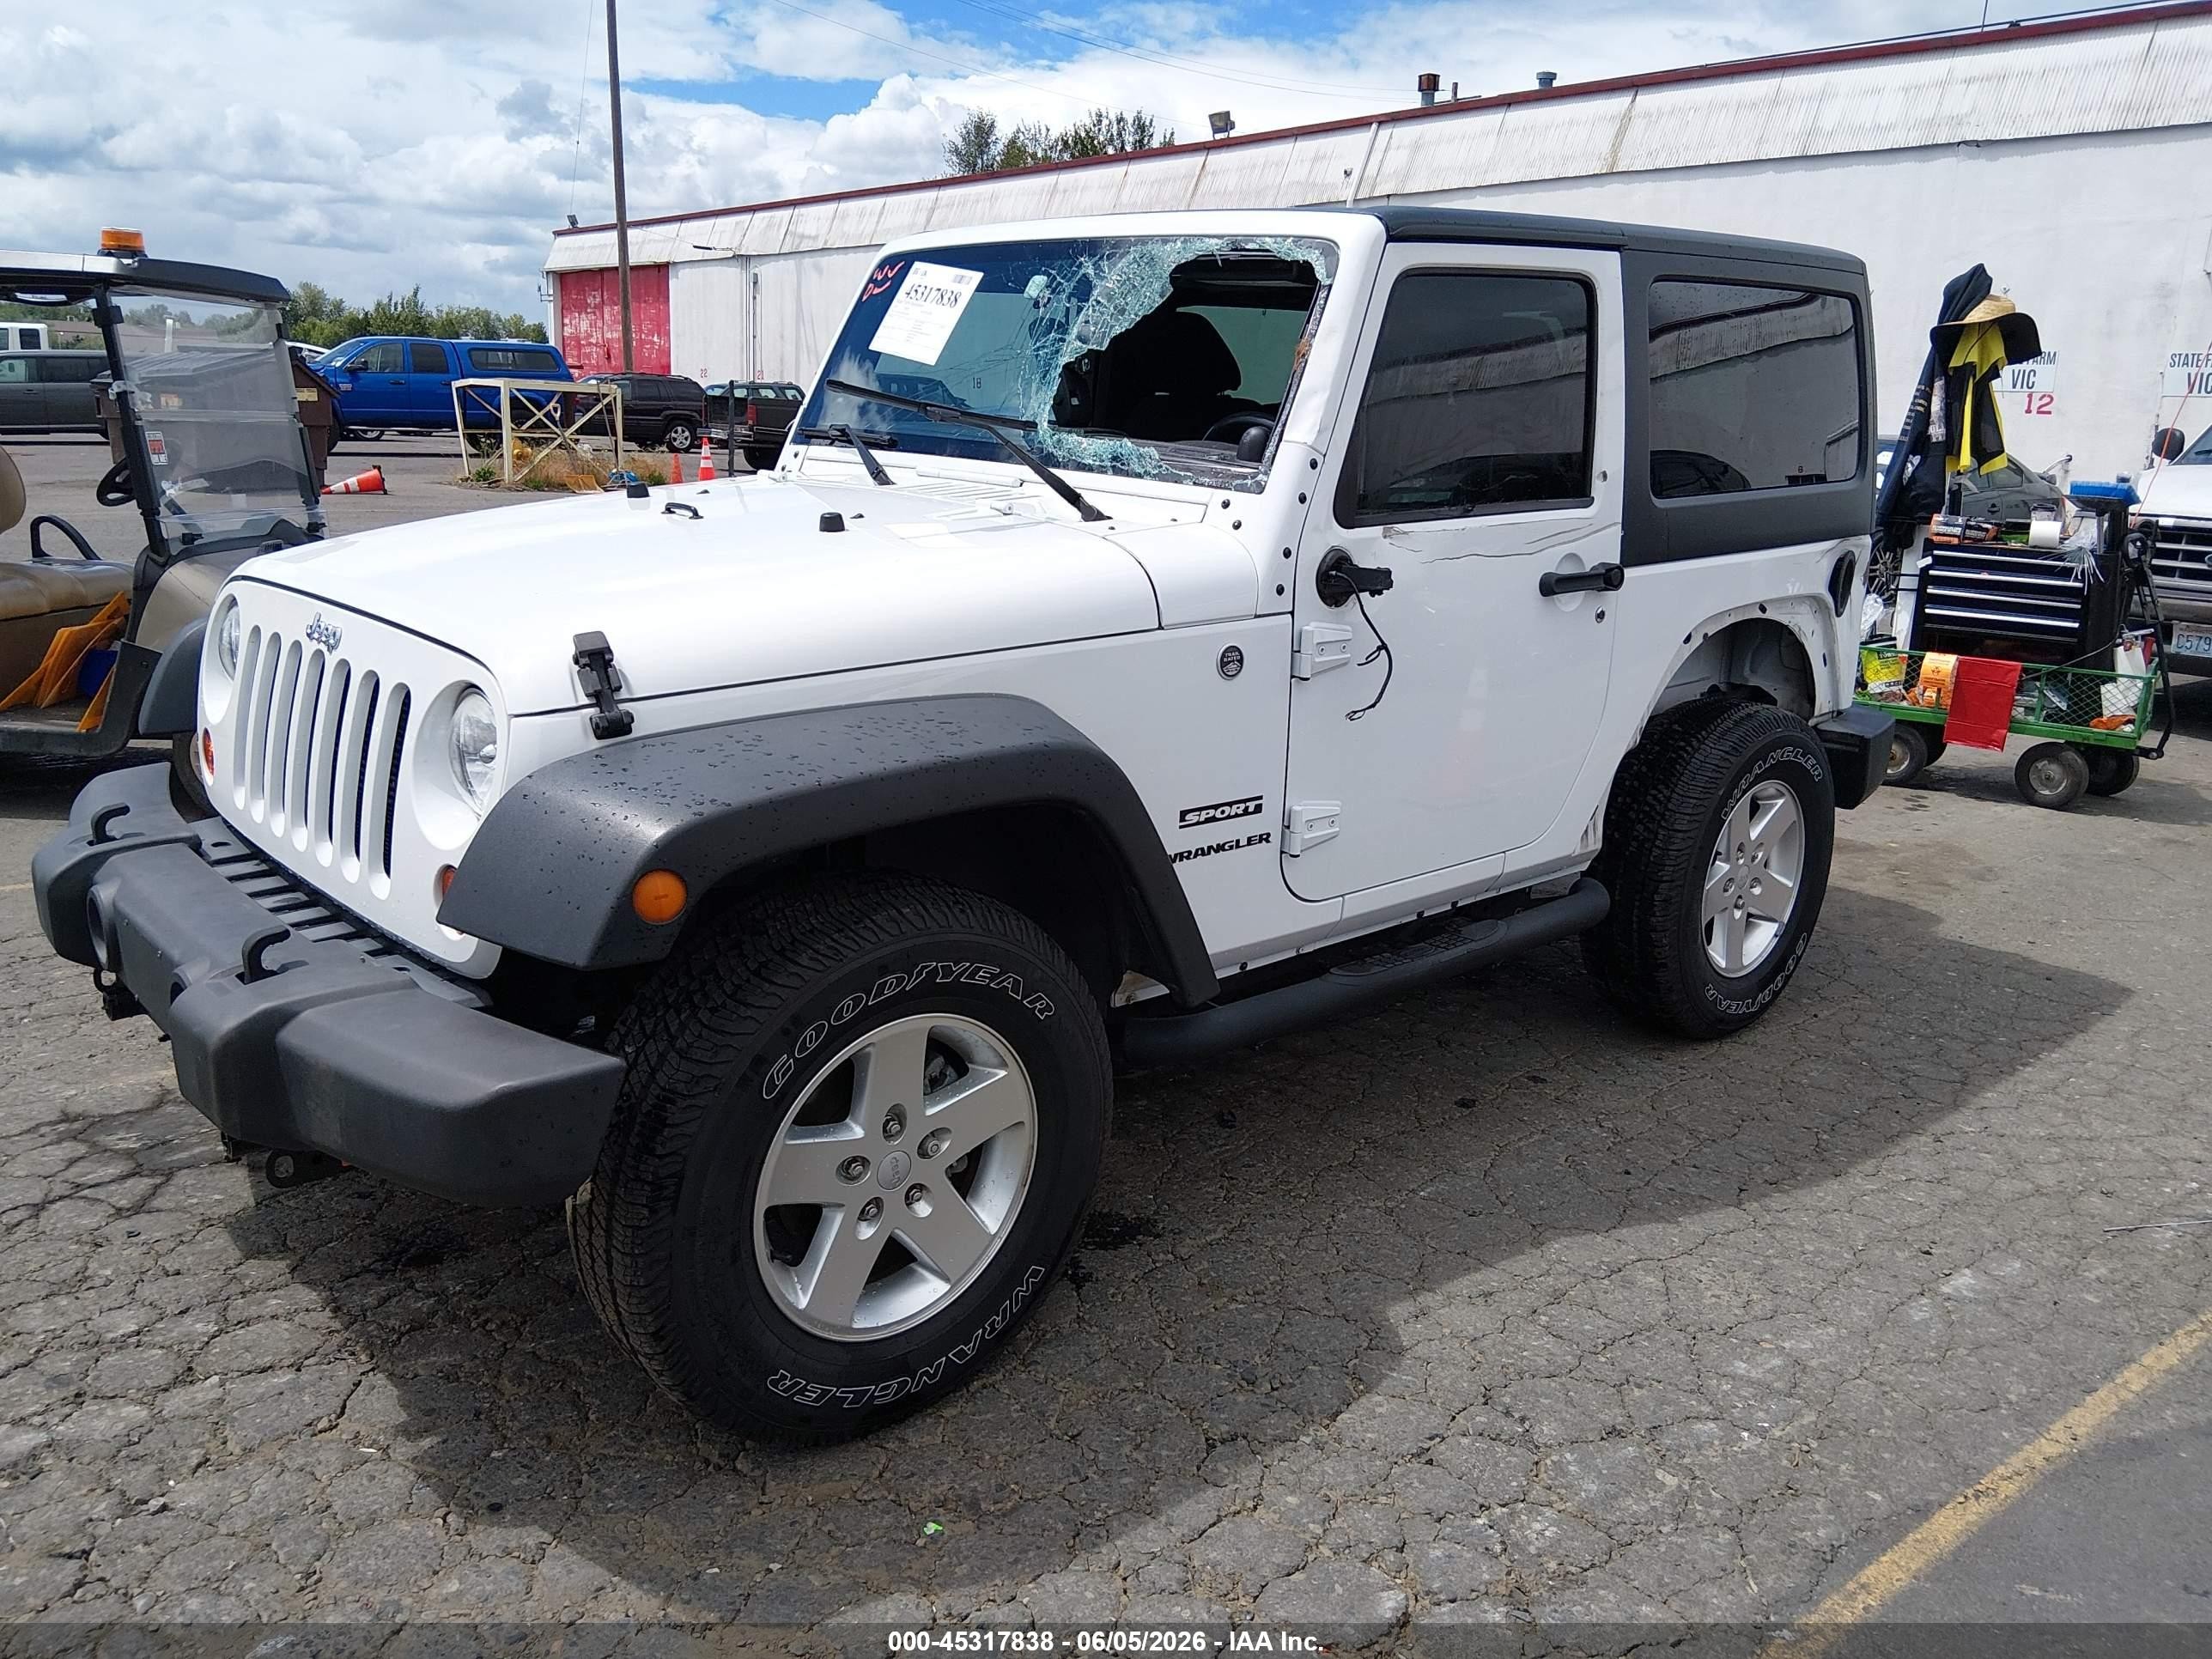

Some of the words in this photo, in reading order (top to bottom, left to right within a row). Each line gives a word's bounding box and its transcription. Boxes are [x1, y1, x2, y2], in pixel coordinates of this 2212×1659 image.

[904, 283, 962, 308] 45317838
[2027, 351, 2057, 365] ARM
[2169, 353, 2203, 368] STATE
[700, 368, 708, 379] 22
[972, 377, 982, 389] 18
[2012, 369, 2037, 389] VIC
[2025, 392, 2054, 415] 12
[306, 611, 343, 654] Jeep
[1721, 746, 1823, 820] WRANGLER
[1182, 800, 1262, 823] SPORT
[767, 1264, 1045, 1408] WRANGLER
